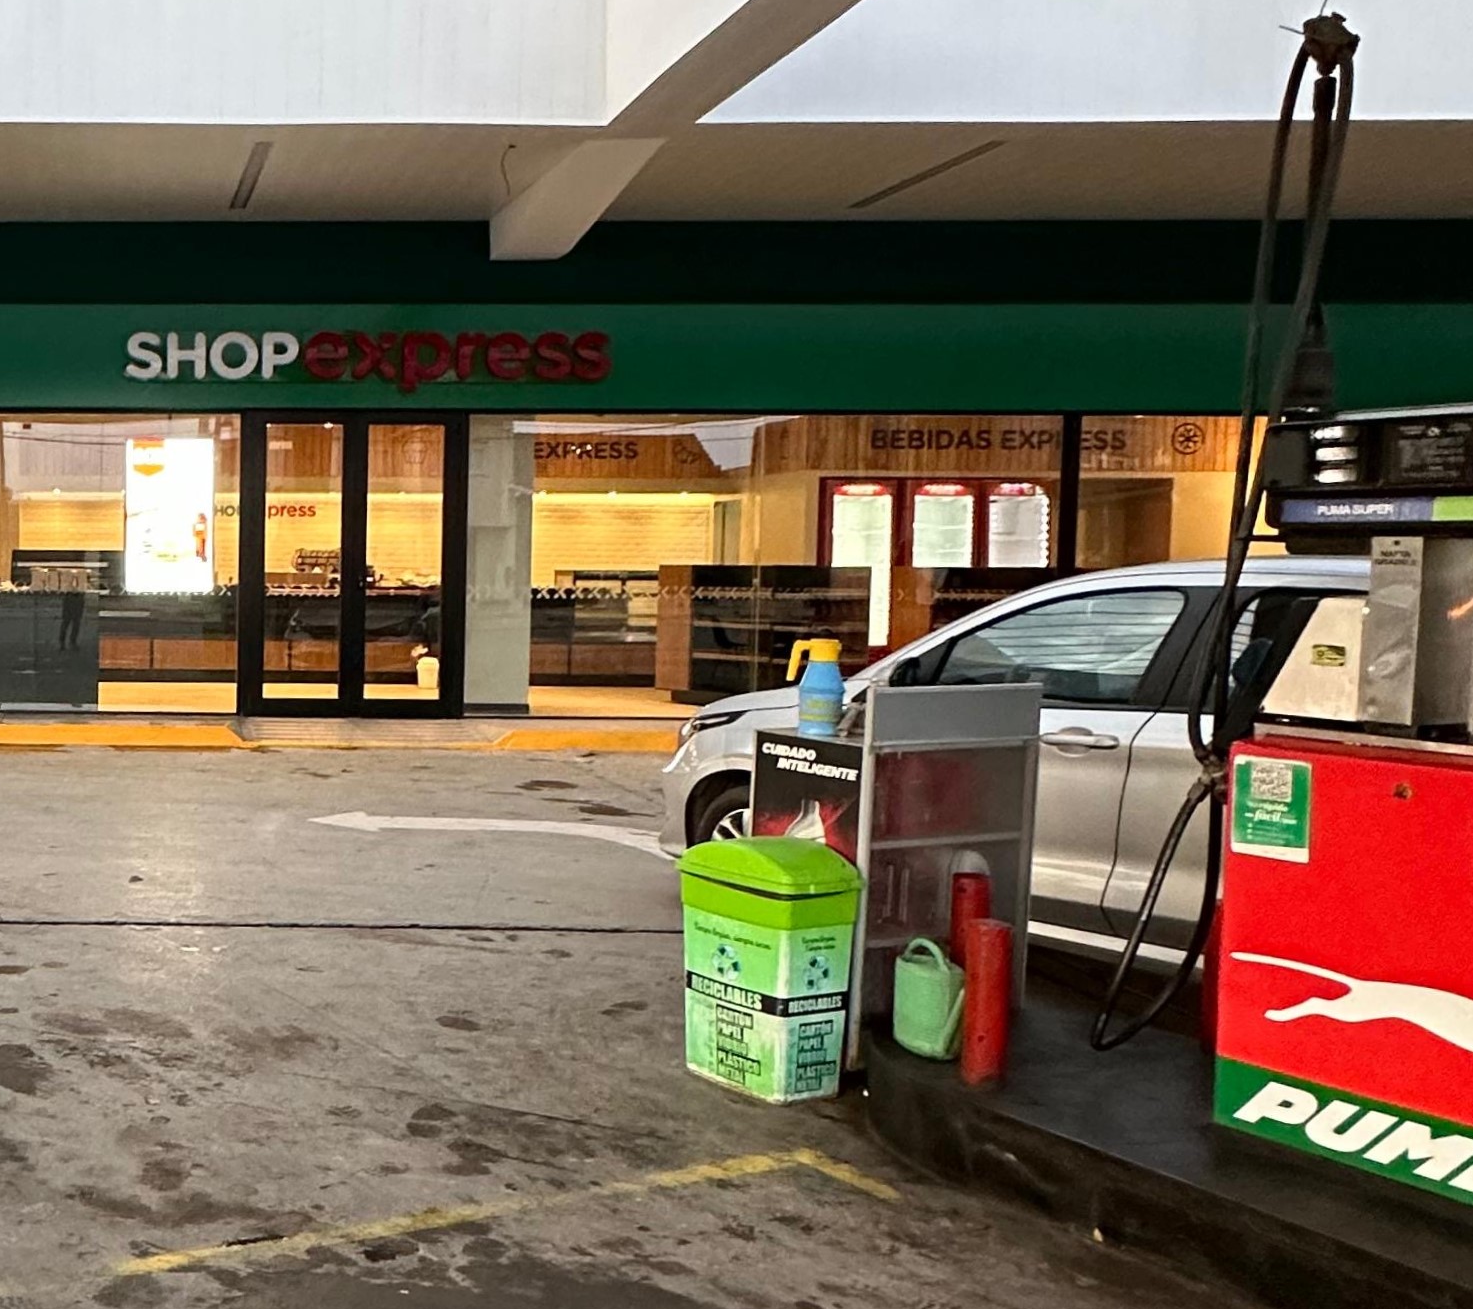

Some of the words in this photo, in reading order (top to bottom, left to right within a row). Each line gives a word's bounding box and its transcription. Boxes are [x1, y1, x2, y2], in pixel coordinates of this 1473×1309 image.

[870, 429, 992, 451] BEBIDAS
[1001, 429, 1127, 450] EXPESS
[533, 441, 639, 460] EXPRESS
[1317, 504, 1351, 516] PUMA
[1352, 503, 1395, 515] SUPER
[761, 742, 817, 761] CUIDADO
[776, 757, 859, 781] INTELIGENTE
[691, 973, 763, 1011] RECICLABLES
[788, 995, 843, 1014] RECICLABLES
[718, 1021, 742, 1040] PAPEL
[799, 1037, 821, 1050] PAPEL
[1232, 1081, 1473, 1193] PUM
